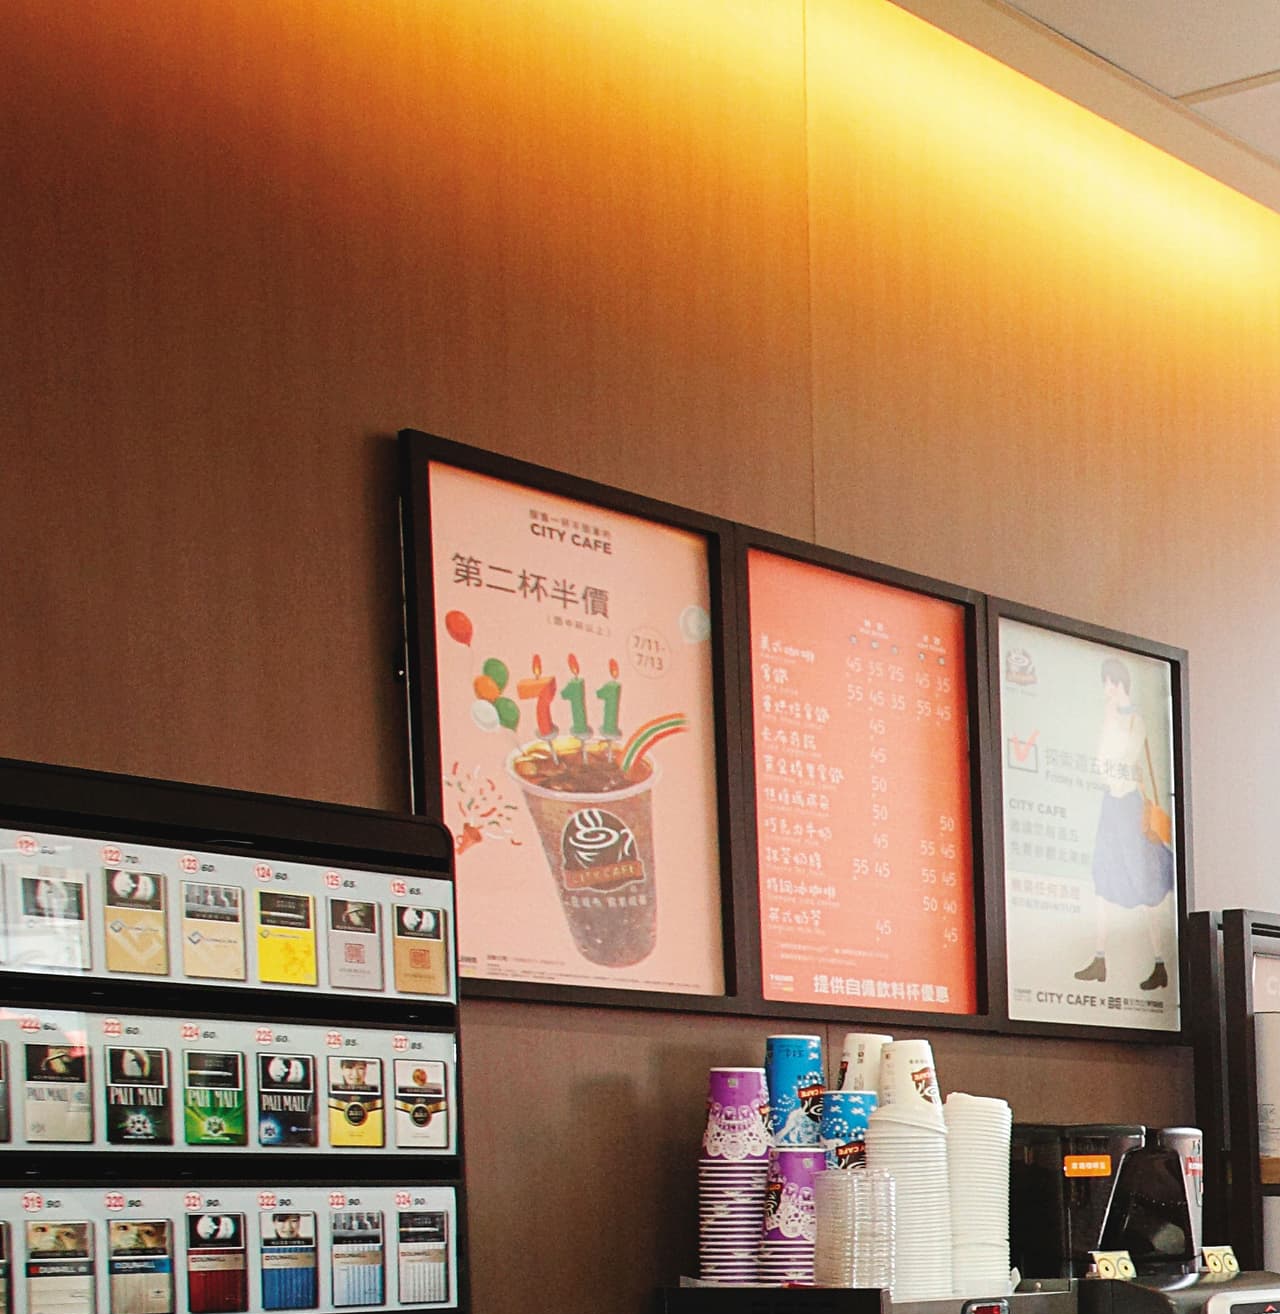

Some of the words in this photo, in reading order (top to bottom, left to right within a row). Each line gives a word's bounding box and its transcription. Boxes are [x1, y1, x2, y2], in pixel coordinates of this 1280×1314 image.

[528, 522, 566, 543] CITY
[570, 533, 613, 556] CAFE
[451, 552, 610, 620] 第二杯半價
[635, 652, 664, 672] 7/13
[871, 776, 888, 794] 50
[871, 804, 888, 822] 50
[940, 816, 955, 833] 50
[1008, 797, 1034, 813] CITY
[1037, 803, 1067, 819] CAFE
[873, 833, 889, 849] 45
[920, 840, 936, 857] 55
[255, 866, 271, 879] 124
[852, 858, 869, 875] 55
[875, 862, 891, 879] 45
[921, 868, 937, 885] 55
[922, 896, 938, 912] 50
[876, 920, 892, 936] 45
[812, 974, 951, 1004] 提供自備飲料杯優惠
[1035, 991, 1065, 1006] CITY
[1066, 993, 1098, 1008] CAFE
